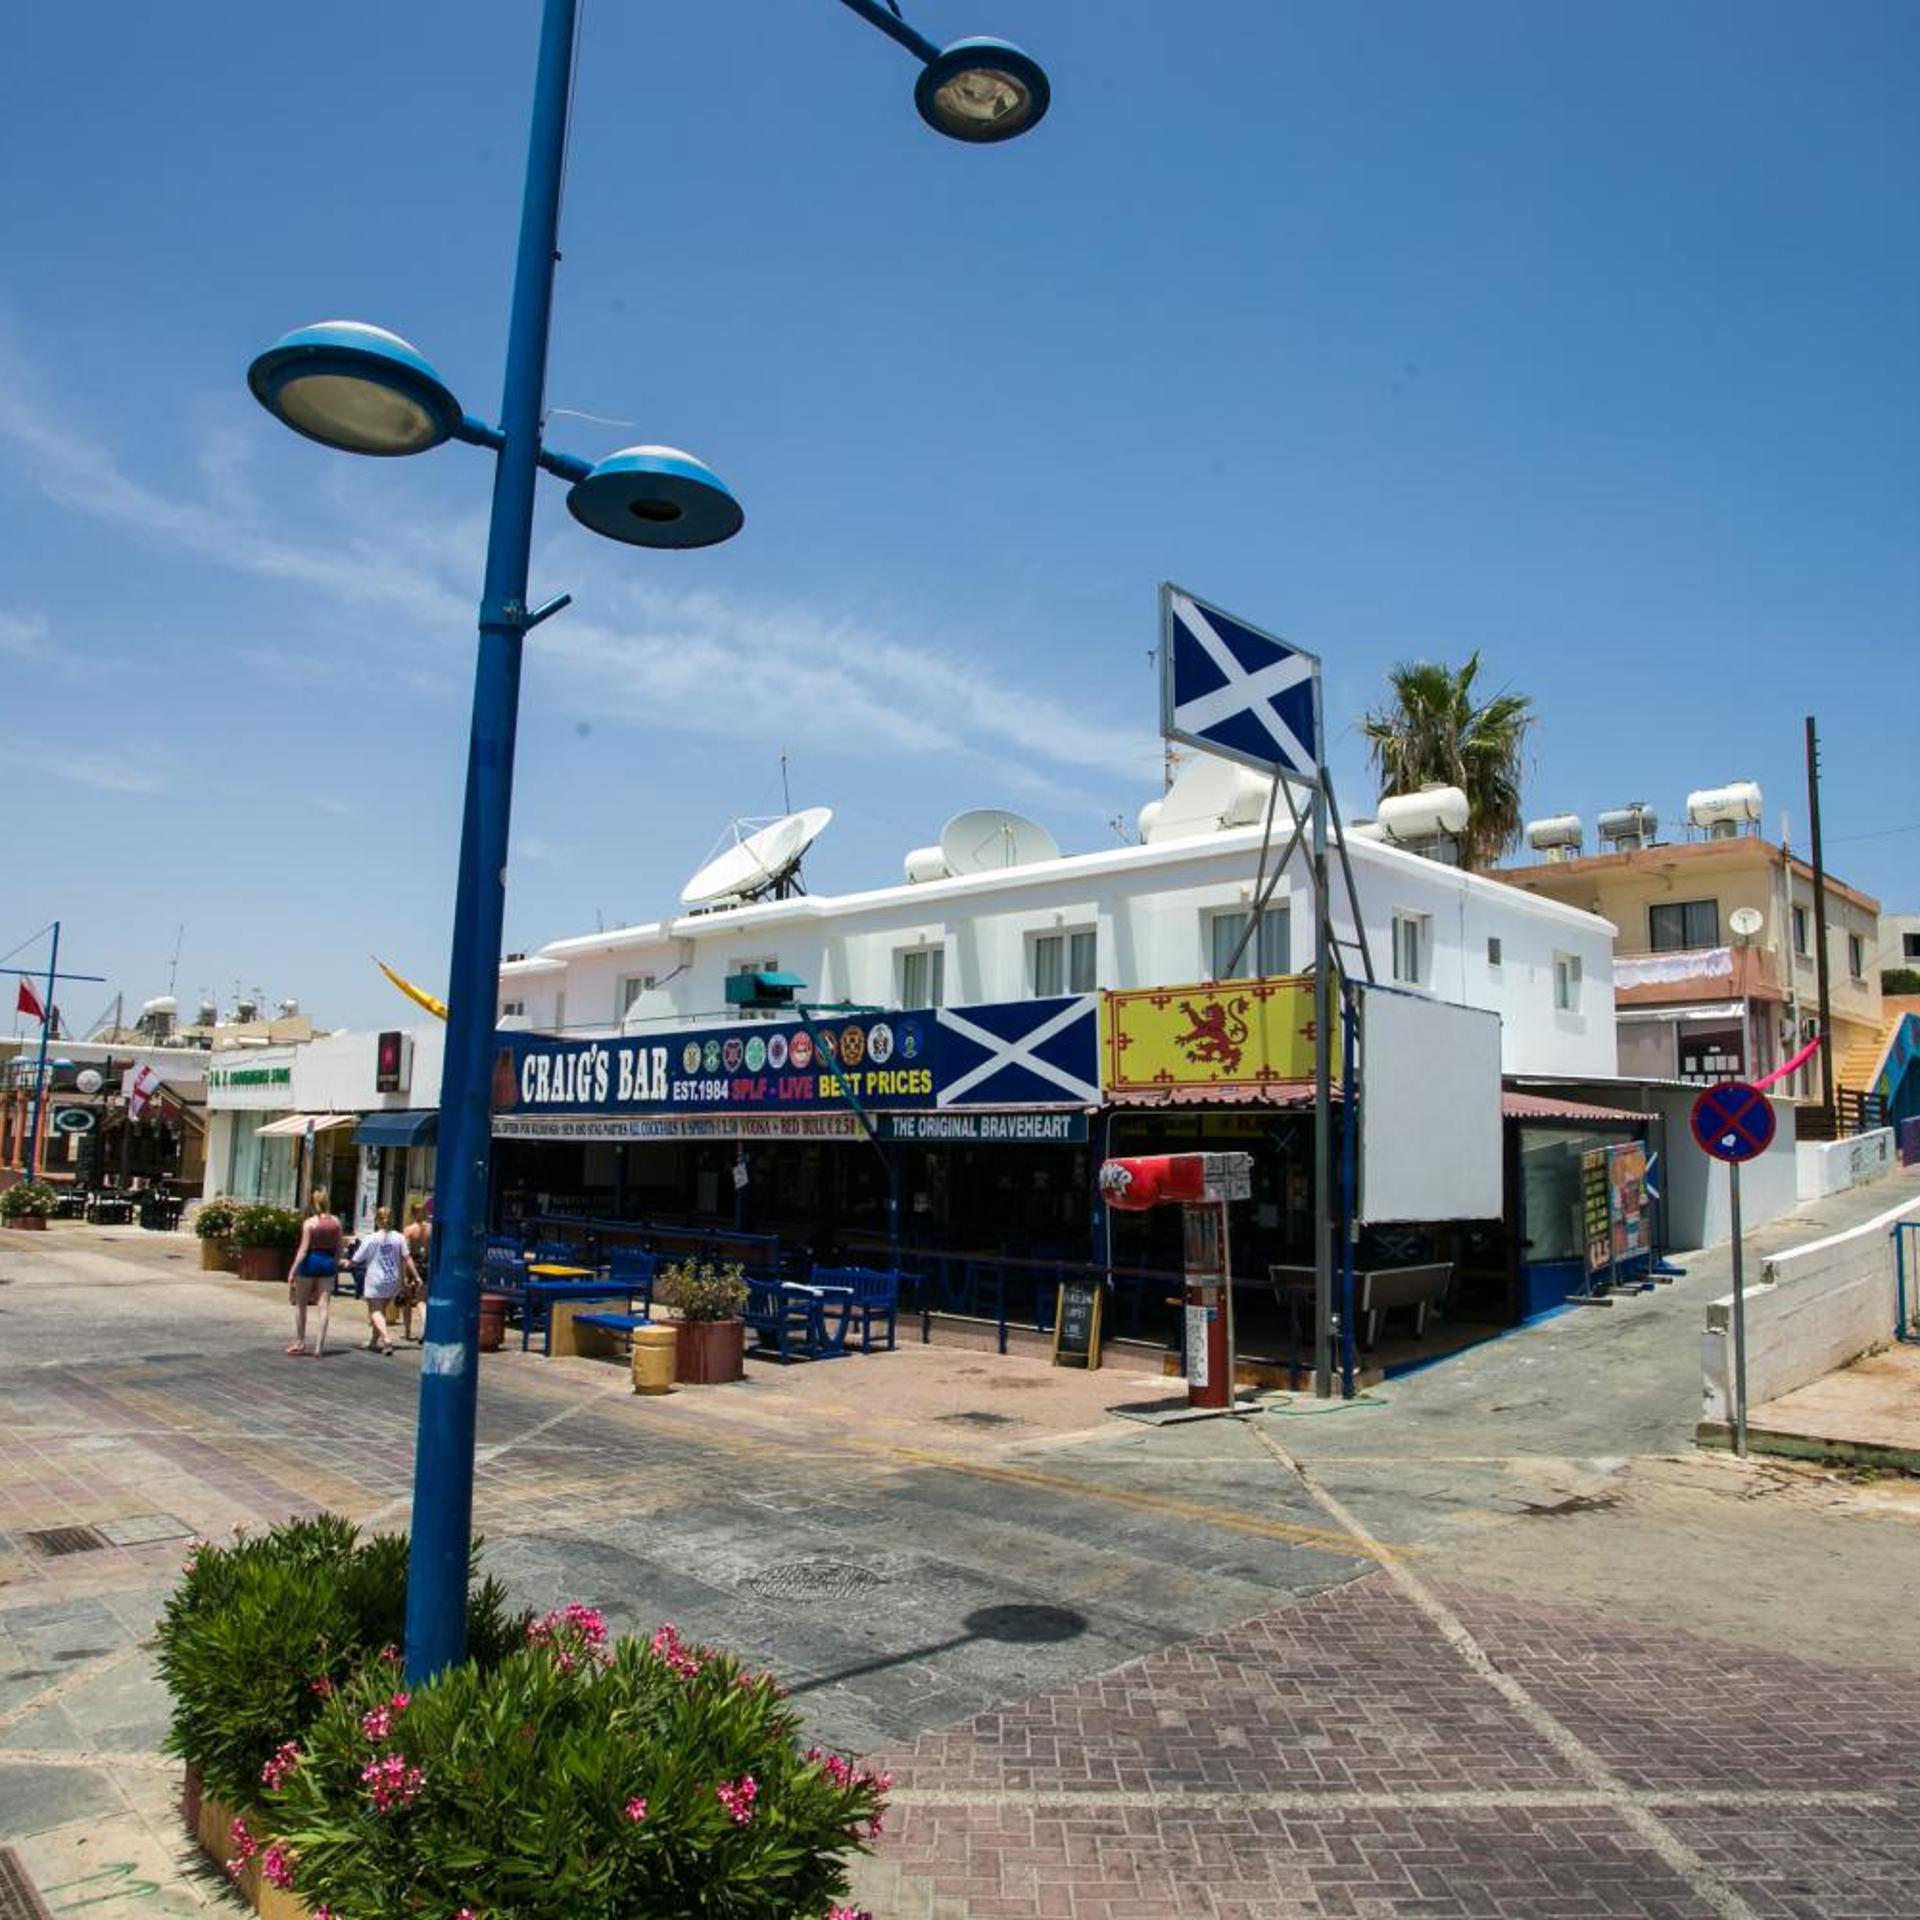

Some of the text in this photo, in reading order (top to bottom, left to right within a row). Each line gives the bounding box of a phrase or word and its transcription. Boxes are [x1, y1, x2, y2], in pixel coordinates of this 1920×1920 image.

[521, 1043, 668, 1103] CRAIG'S BAR
[673, 1080, 729, 1101] EST.1984
[779, 1075, 812, 1099] LIVE
[866, 1069, 932, 1095] PRICES
[780, 1116, 799, 1135] RED
[801, 1116, 826, 1136] BULL
[892, 1115, 1071, 1138] THE ORIGINAL BRAVEHEART
